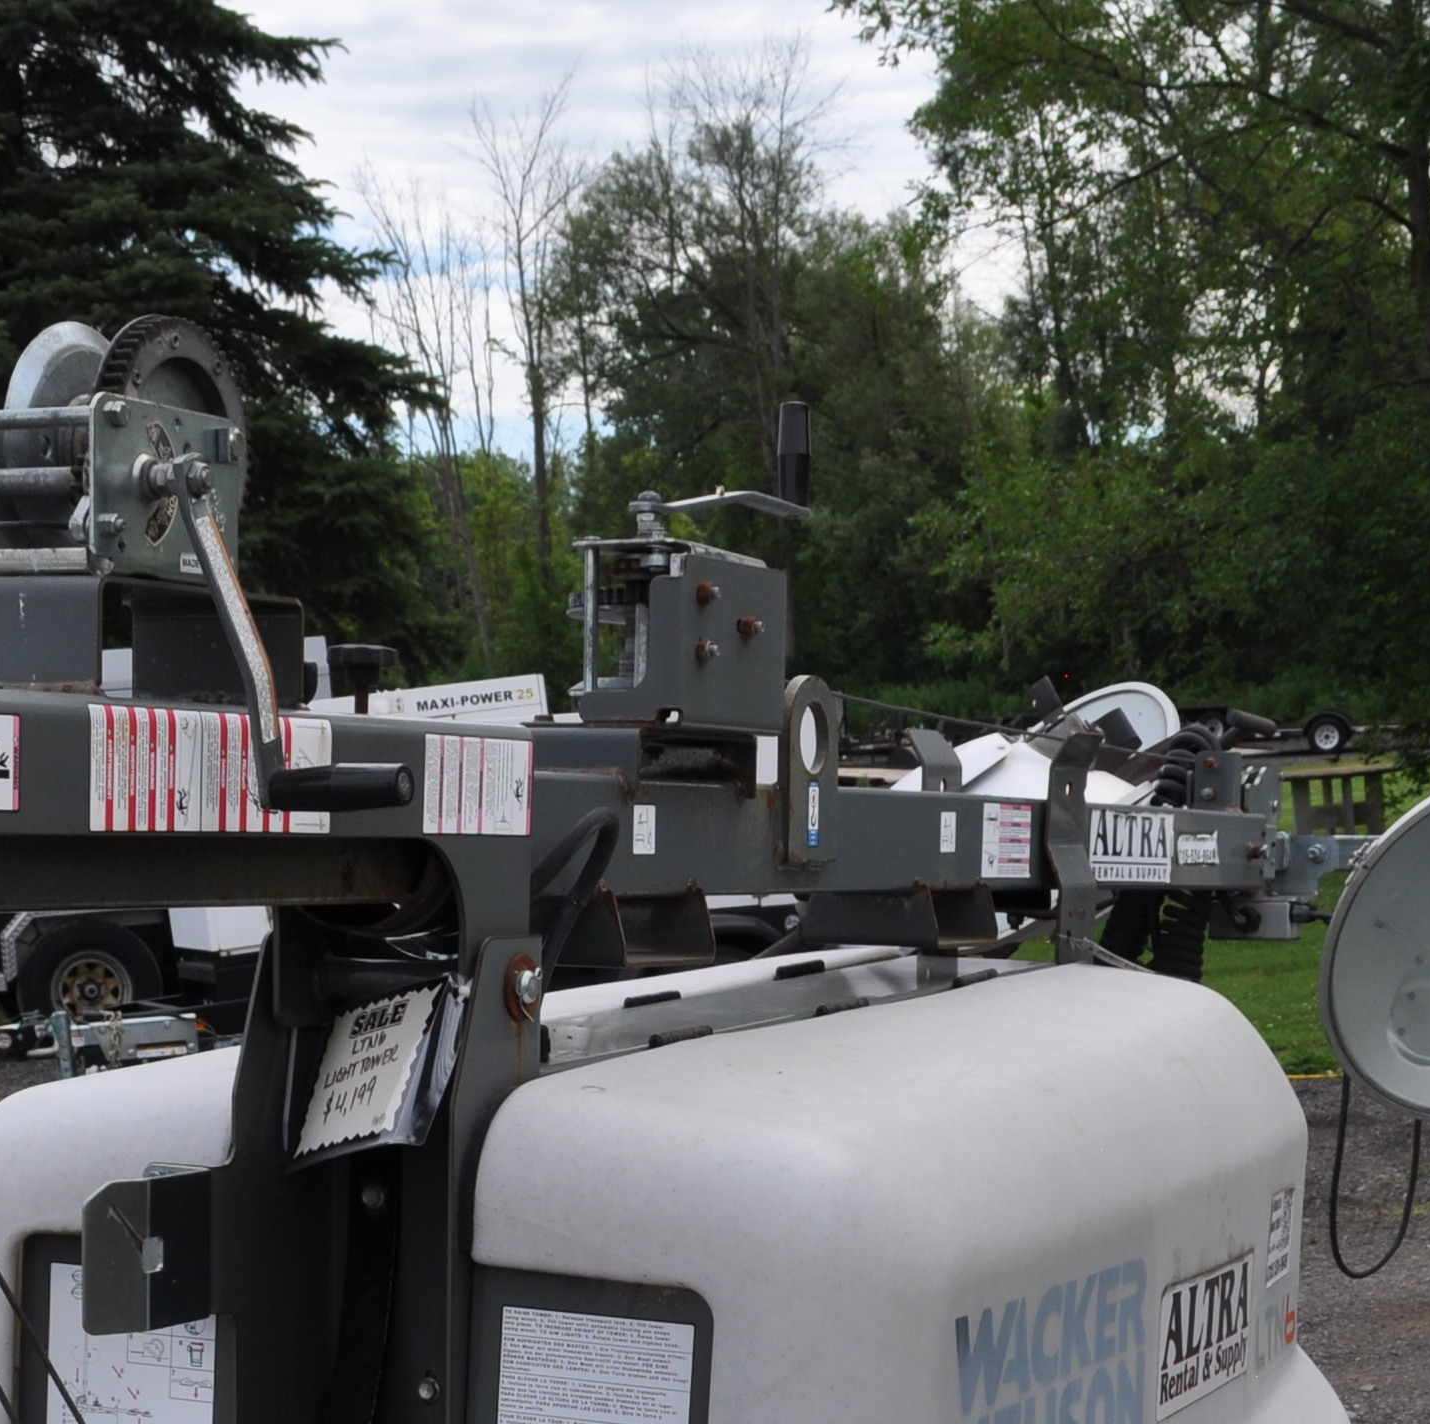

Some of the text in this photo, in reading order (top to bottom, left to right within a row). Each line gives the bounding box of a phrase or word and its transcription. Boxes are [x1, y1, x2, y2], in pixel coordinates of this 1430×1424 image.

[416, 688, 533, 712] MAXI-POWER 25
[1093, 809, 1168, 859] ALTRA
[1092, 866, 1125, 878] RENTAL
[1136, 868, 1167, 879] SUPPLY
[350, 1000, 409, 1038] SALE
[324, 1044, 398, 1089] LIGHT TOWER
[323, 1076, 377, 1124] $4,199
[955, 1258, 1147, 1416] WACKER
[1161, 1261, 1249, 1371] ALTRA
[1159, 1332, 1248, 1405] Rental & Supply
